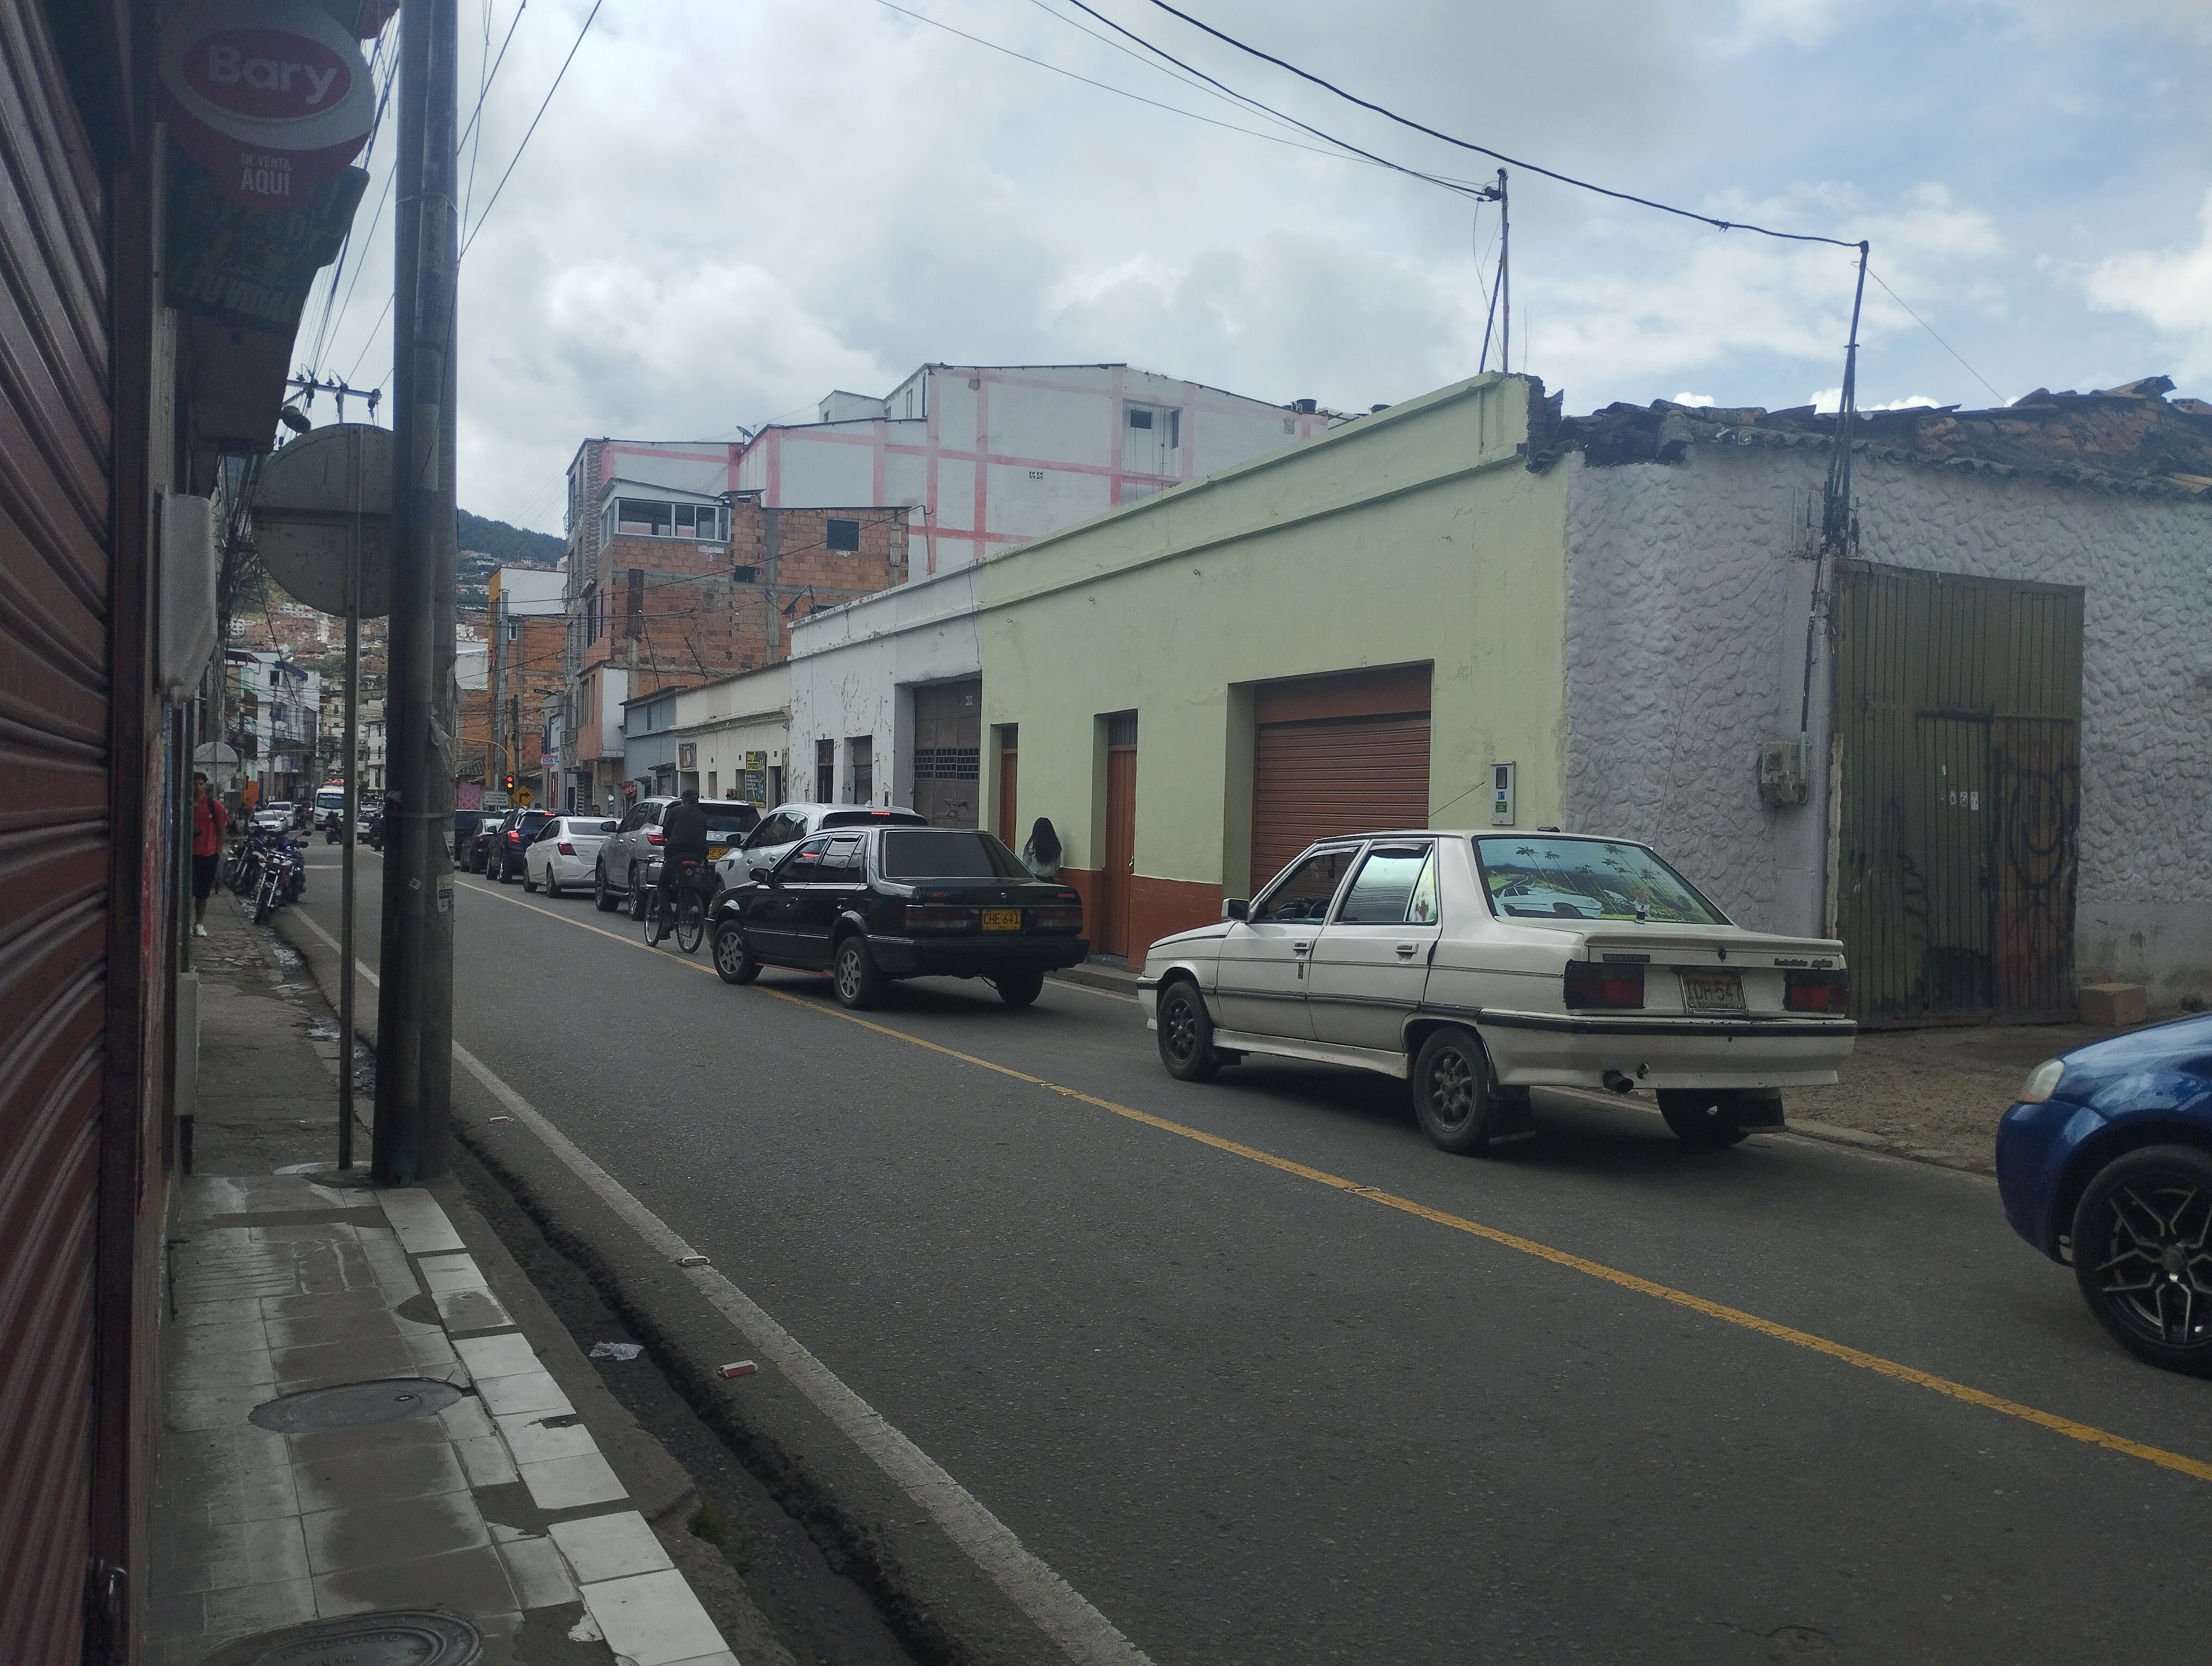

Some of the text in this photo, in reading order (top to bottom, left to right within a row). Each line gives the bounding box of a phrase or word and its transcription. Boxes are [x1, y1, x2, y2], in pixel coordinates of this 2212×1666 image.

[208, 44, 337, 104] Bary
[241, 153, 290, 170] DE VENTA
[984, 913, 1019, 925] CHE 641
